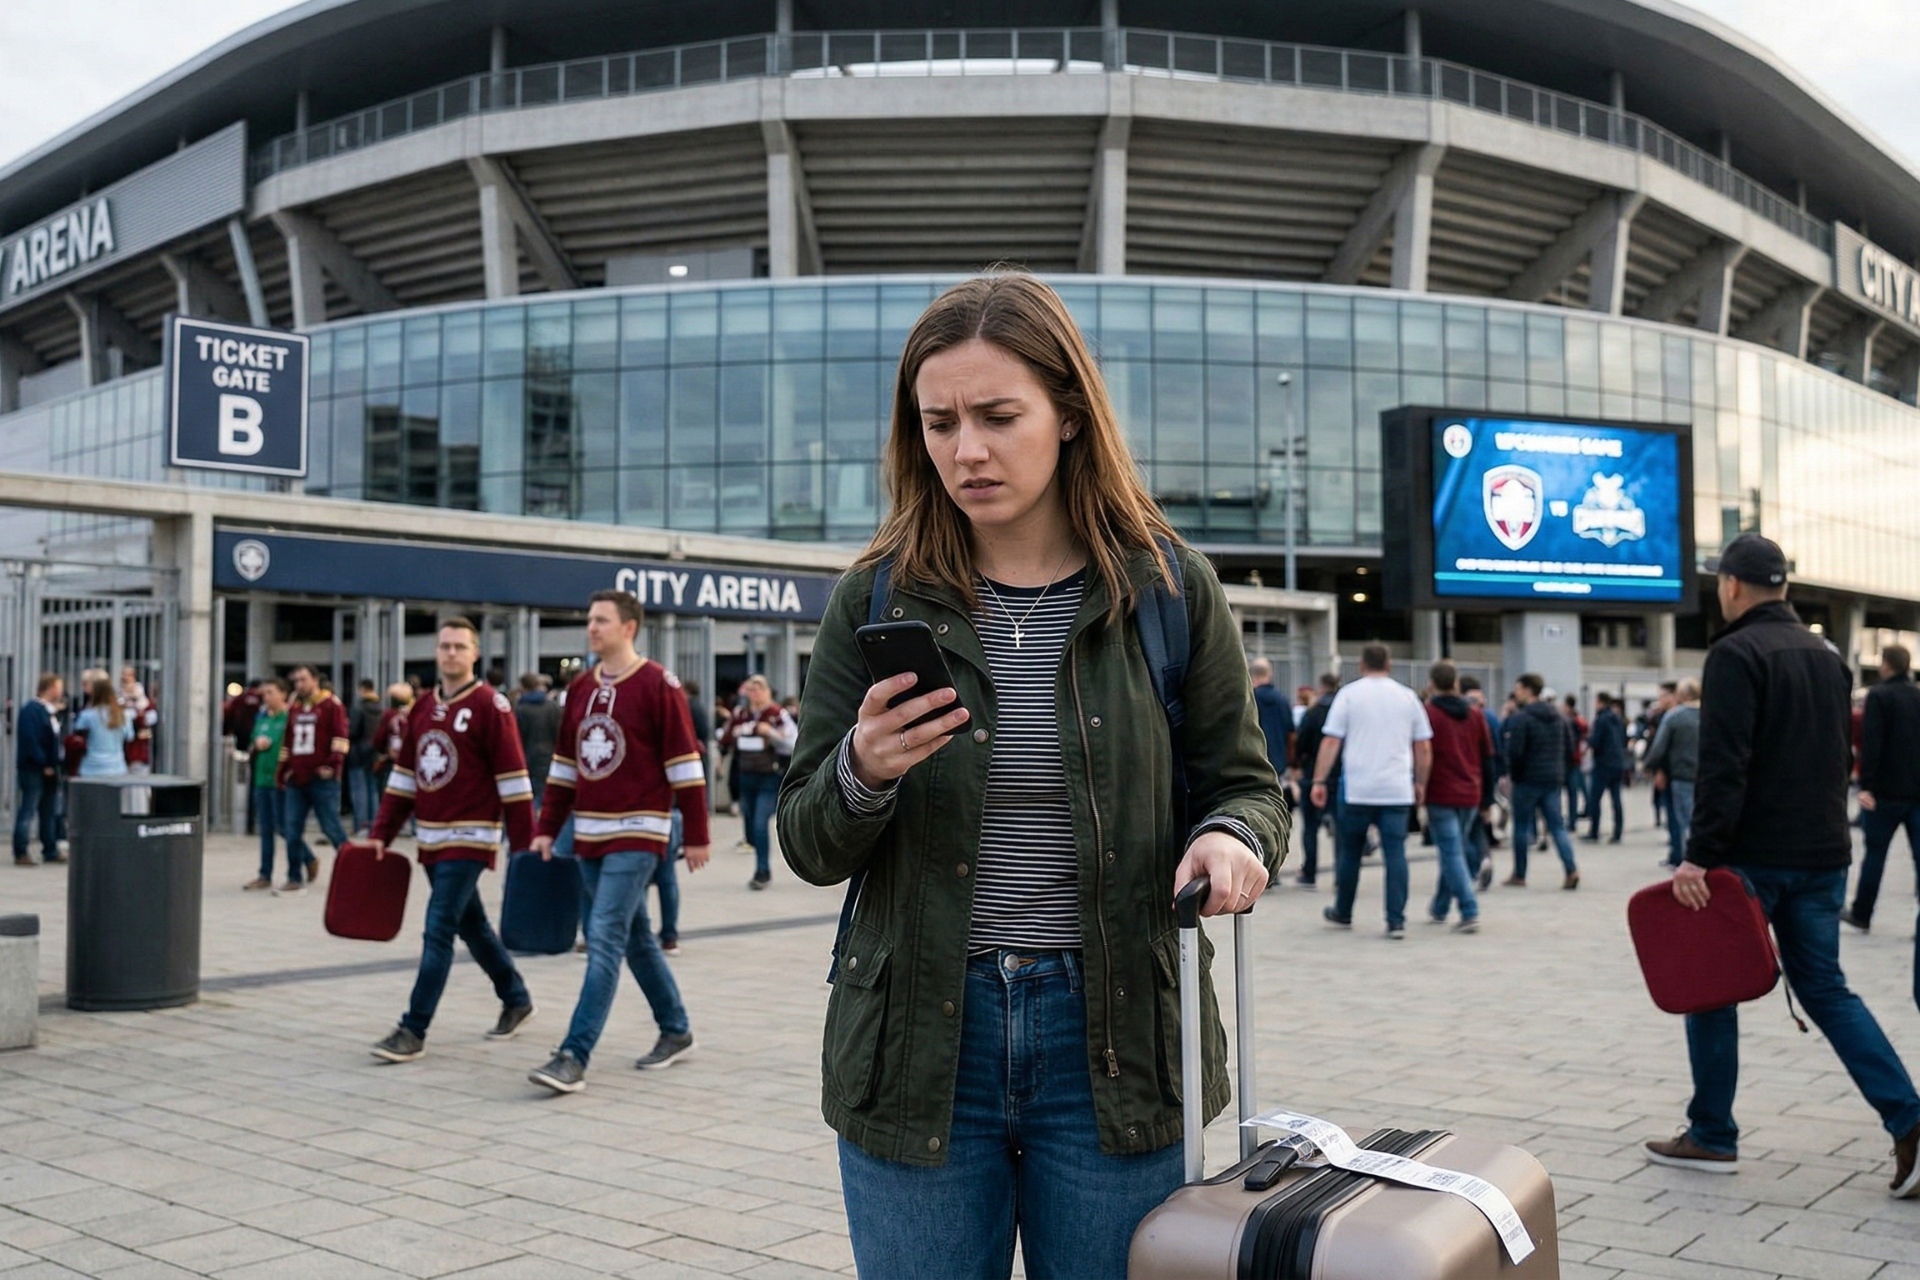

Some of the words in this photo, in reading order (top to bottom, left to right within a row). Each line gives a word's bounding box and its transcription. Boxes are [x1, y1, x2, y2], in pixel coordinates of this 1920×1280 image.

[9, 197, 113, 294] ARENA
[1861, 243, 1908, 315] CITY
[195, 335, 289, 371] TICKET
[212, 365, 271, 393] GATE
[218, 393, 264, 456] B
[615, 567, 690, 607] CITY
[696, 574, 802, 613] ARENA
[453, 707, 472, 733] C
